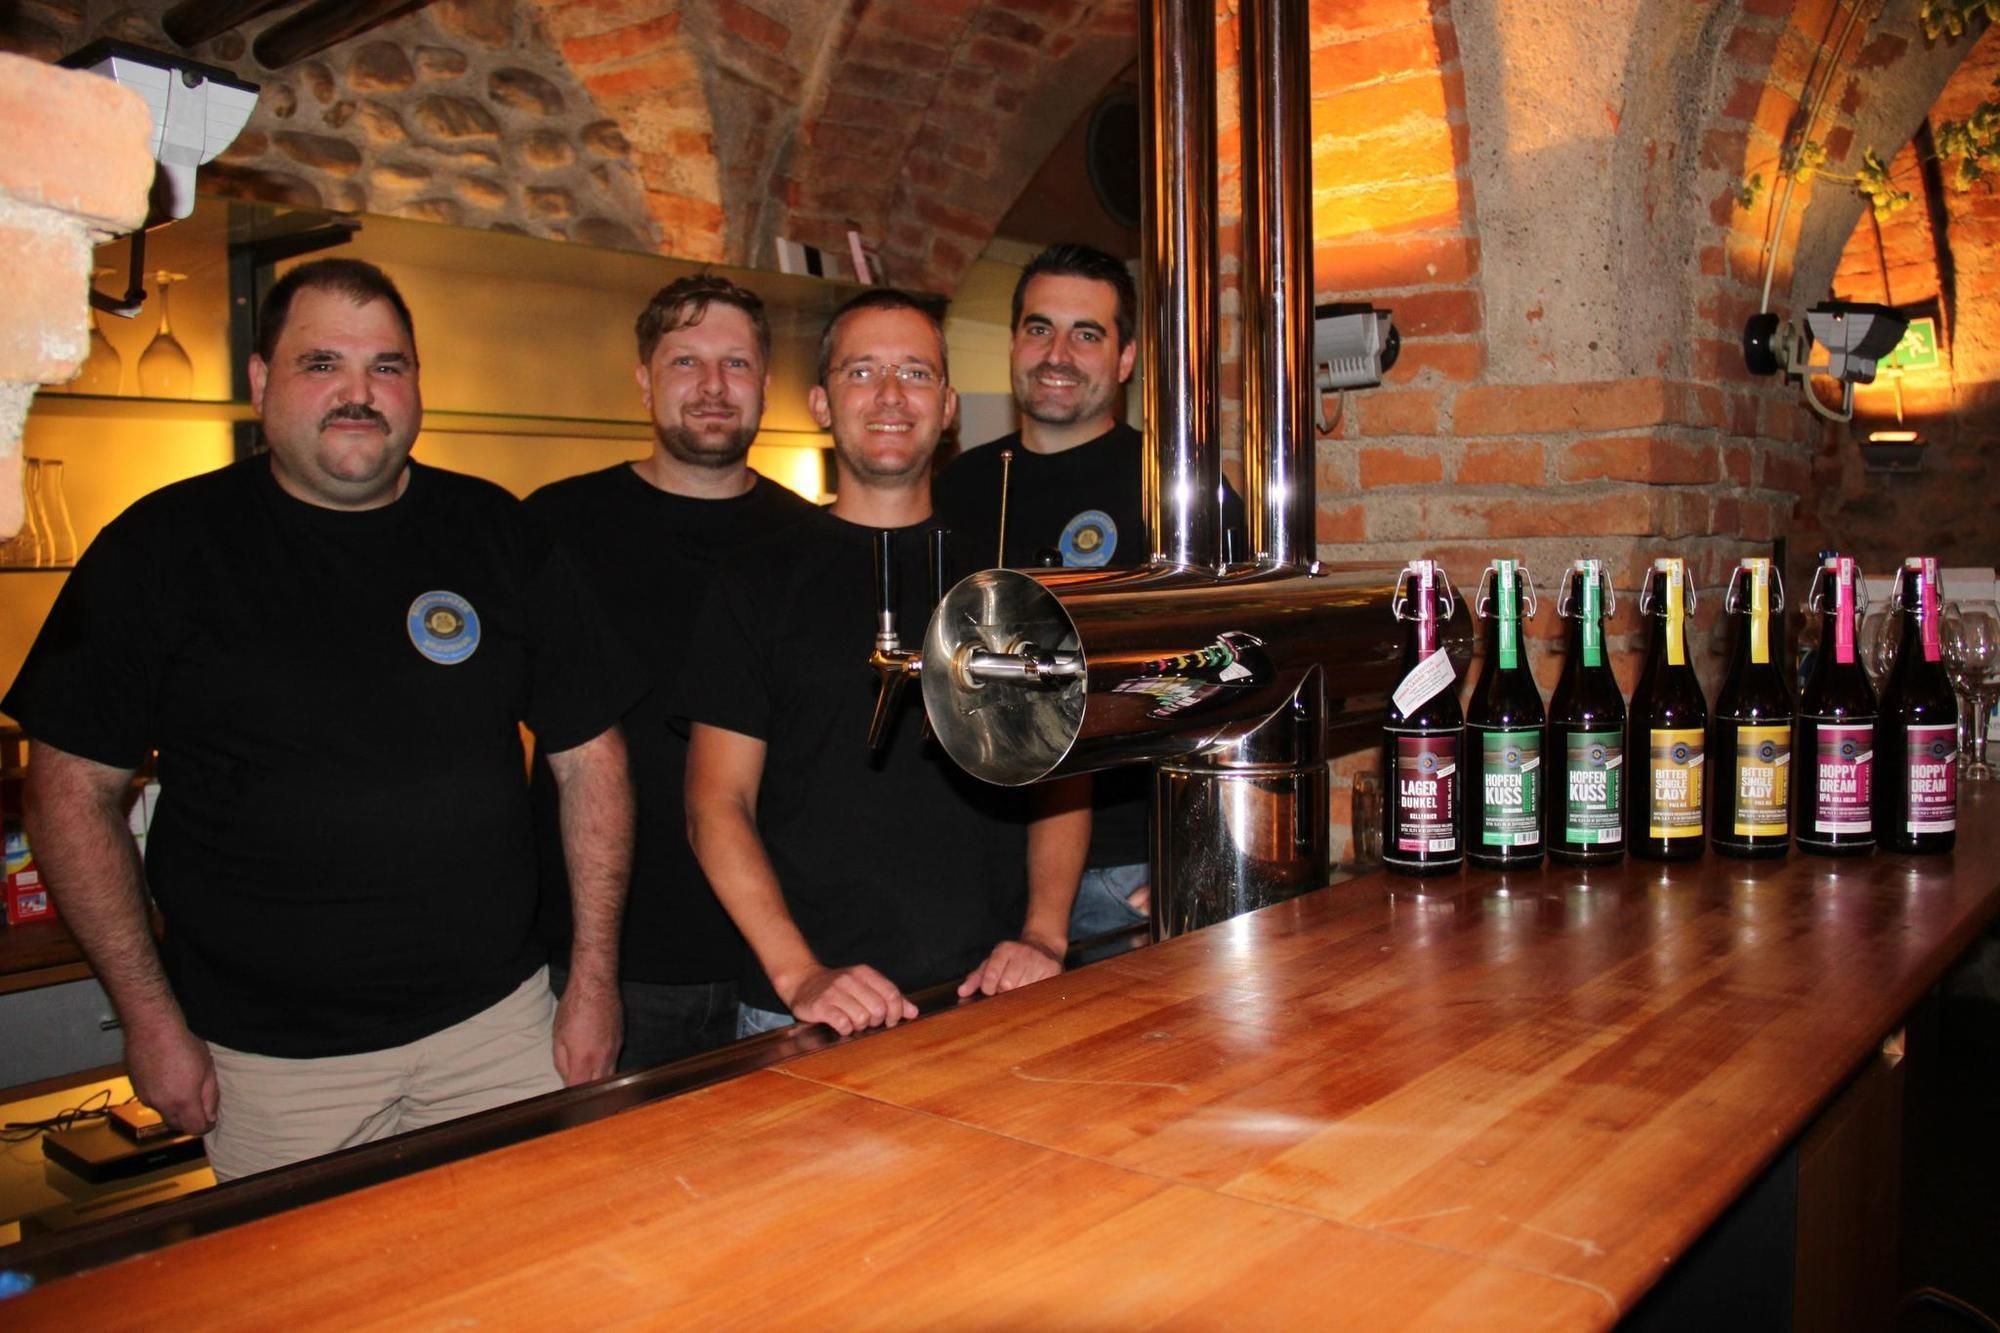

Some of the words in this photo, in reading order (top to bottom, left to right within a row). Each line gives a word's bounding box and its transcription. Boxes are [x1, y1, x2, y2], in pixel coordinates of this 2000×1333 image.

[1569, 770, 1606, 784] HOPFEN
[1655, 768, 1688, 779] BITTER
[1741, 767, 1774, 777] BITTER
[1820, 764, 1856, 779] HOPPY
[1911, 764, 1947, 779] HOPPY
[1485, 773, 1522, 787] HOPFEN
[1655, 778, 1688, 789] SINGLE
[1819, 778, 1857, 793] DREAM
[1911, 778, 1947, 793] DREAM
[1401, 779, 1438, 796] LAGER
[1569, 783, 1607, 802] KUSS
[1655, 788, 1688, 800] LADY
[1740, 786, 1773, 798] LADY
[1401, 796, 1438, 809] DUNKEL
[1485, 786, 1523, 806] KUSS
[1819, 793, 1831, 803] IPA
[1911, 793, 1924, 803] IPA
